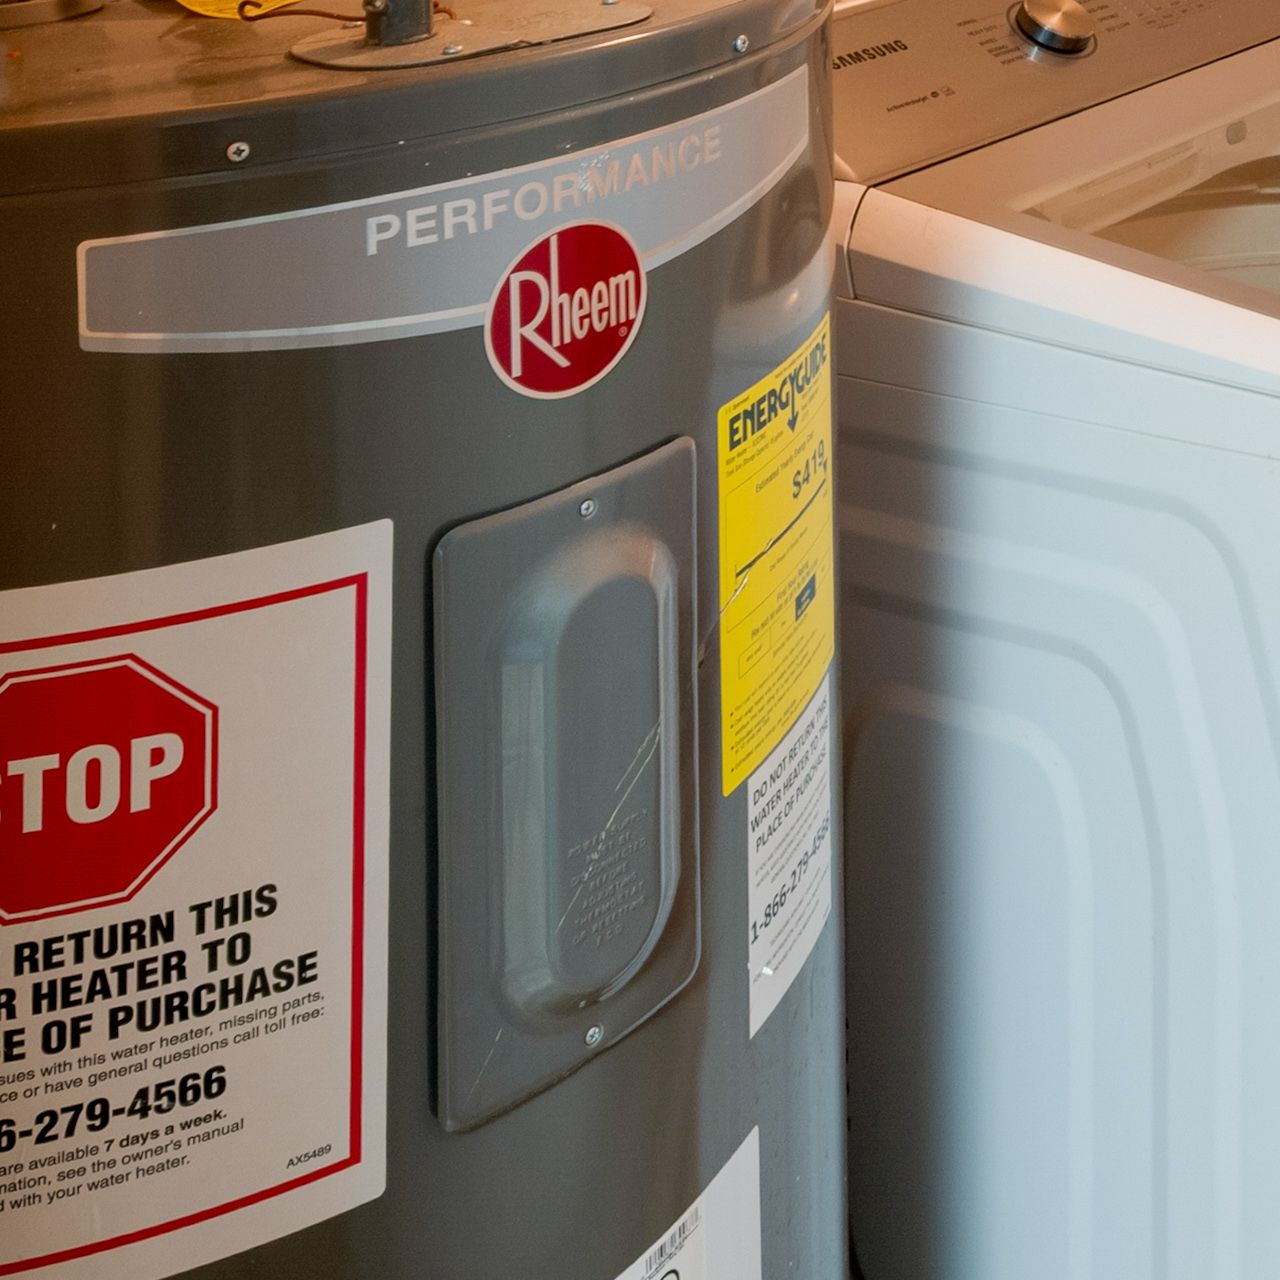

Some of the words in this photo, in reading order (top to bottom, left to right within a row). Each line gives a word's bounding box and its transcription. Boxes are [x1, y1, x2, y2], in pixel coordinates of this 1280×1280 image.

[366, 125, 722, 256] PERFORMANCE
[510, 234, 637, 379] Rheem
[0, 732, 184, 835] TOP
[750, 789, 782, 833] WATER
[783, 750, 810, 795] HEATER
[753, 780, 768, 806] DO
[770, 756, 787, 788] NOT
[756, 811, 783, 853] PLACE
[784, 795, 795, 817] OF
[13, 910, 175, 977] RETURN
[188, 883, 279, 936] THIS
[31, 950, 188, 1016] HEATER
[201, 931, 252, 973] TO
[41, 1012, 94, 1055] OF
[108, 950, 319, 1041] PURCHASE
[23, 1085, 41, 1099] or
[44, 1077, 83, 1095] have
[87, 1058, 148, 1087] general
[152, 1037, 229, 1070] questions
[233, 1027, 260, 1045] call
[264, 1018, 287, 1035] toll
[291, 1006, 325, 1026] free:
[40, 1060, 73, 1077] with
[77, 1053, 107, 1068] this
[110, 1040, 156, 1061] water
[159, 1026, 214, 1049] heater,
[218, 1005, 278, 1032] missing
[28, 1143, 100, 1170] available
[104, 1139, 116, 1153] 7
[119, 1128, 160, 1150] days
[164, 1123, 175, 1136] a
[179, 1108, 228, 1132] week.
[56, 1167, 87, 1183] see
[91, 1158, 118, 1174] the
[121, 1139, 183, 1165] owner's
[187, 1118, 245, 1147] manual
[286, 1143, 332, 1169] AX5489
[9, 1193, 42, 1210] with
[47, 1184, 83, 1205] your
[87, 1171, 132, 1192] water
[136, 1154, 191, 1179] heater.
